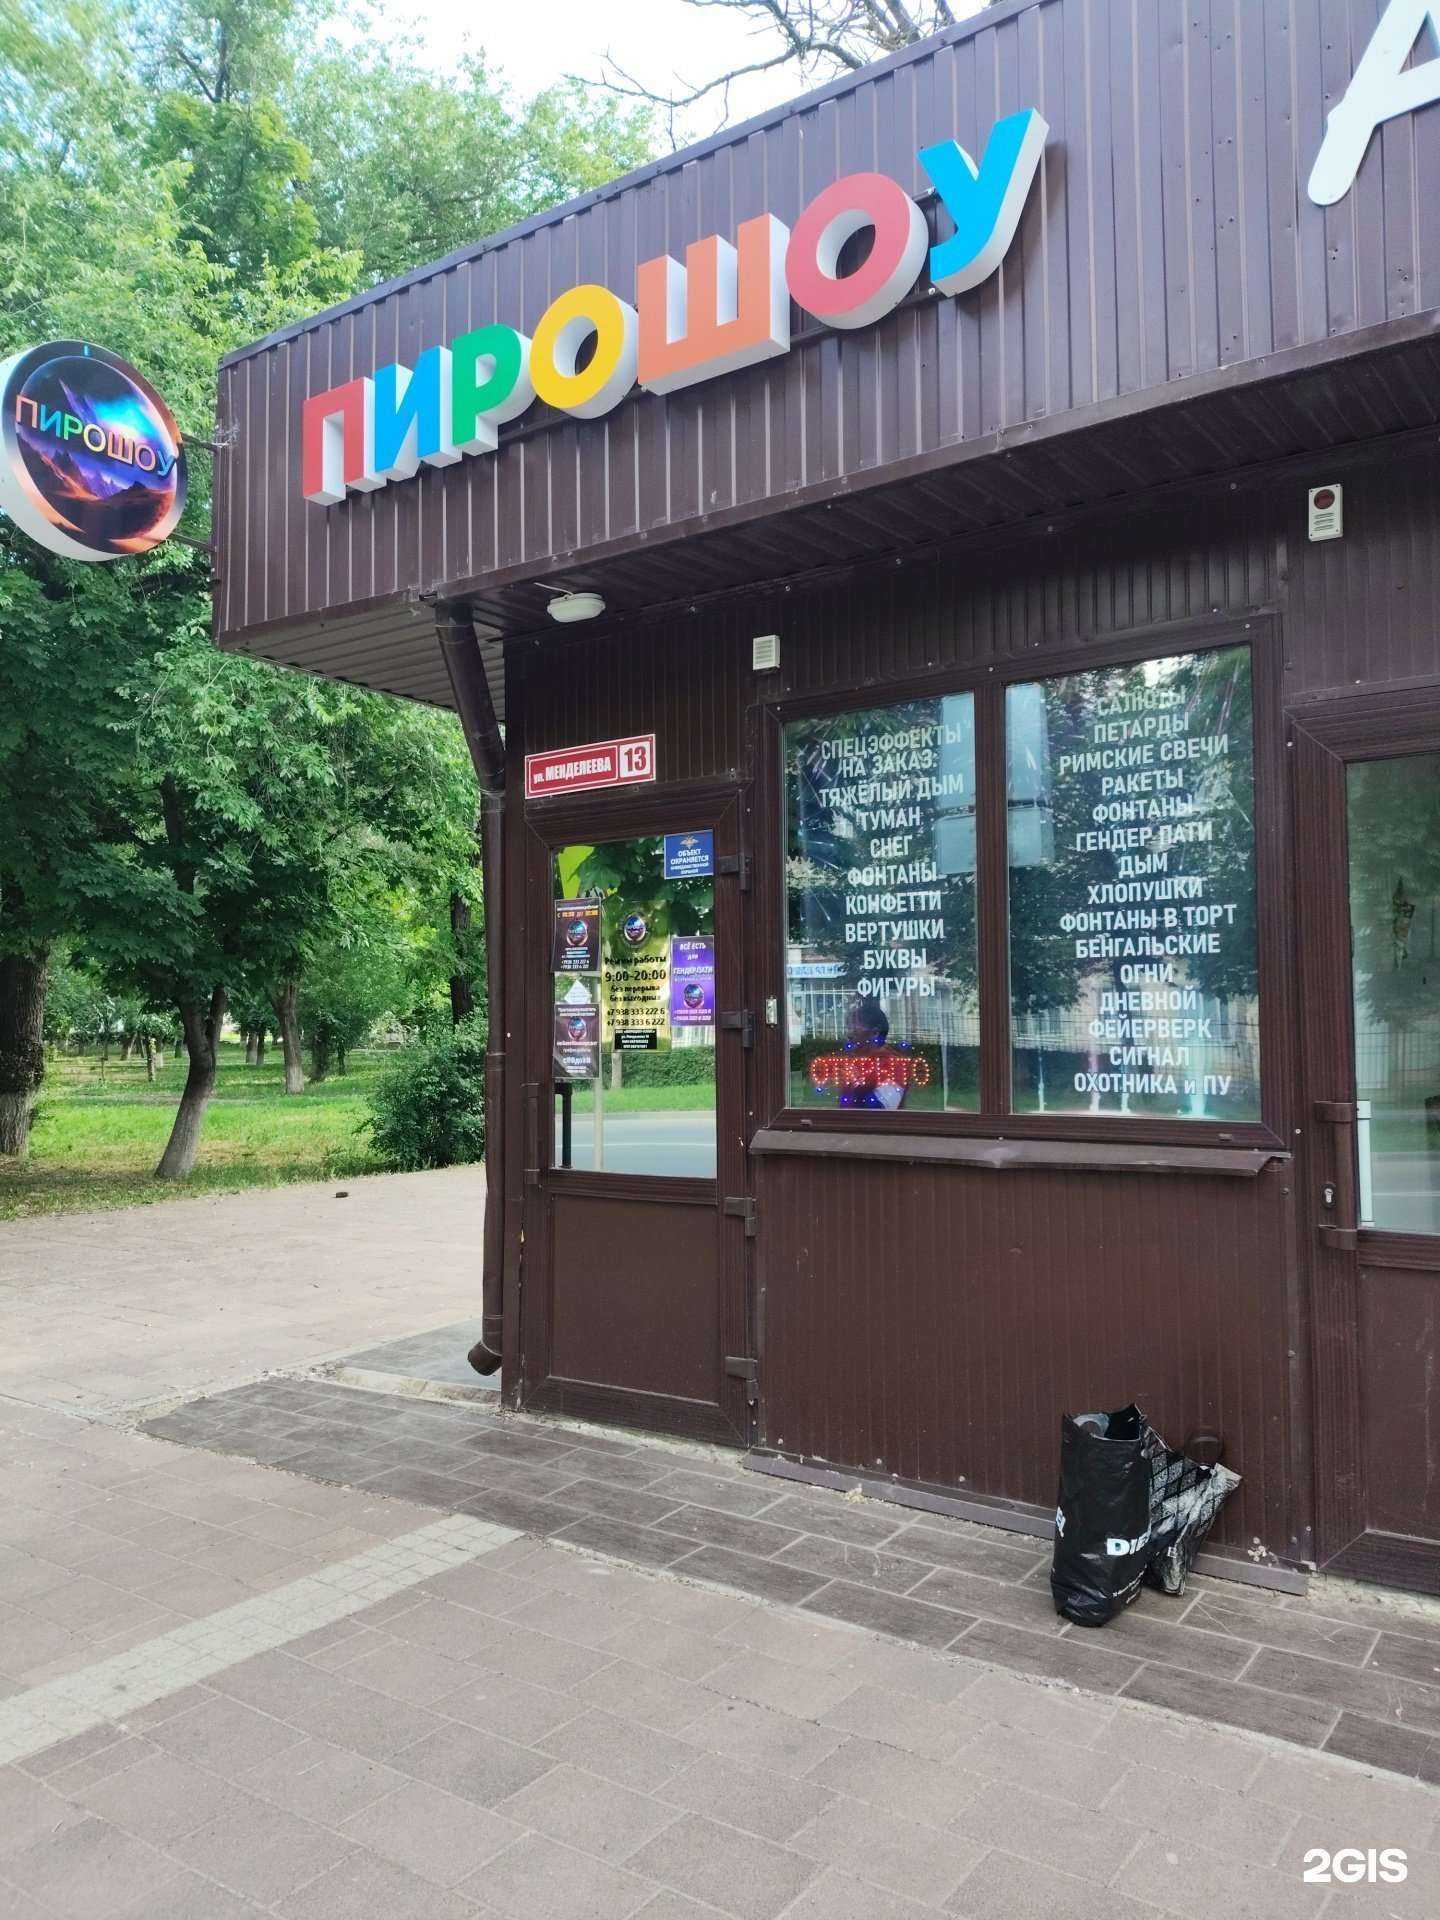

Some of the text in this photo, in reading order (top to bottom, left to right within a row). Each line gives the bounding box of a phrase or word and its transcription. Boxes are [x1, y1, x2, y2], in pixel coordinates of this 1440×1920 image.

[303, 107, 1049, 506] ПИРОШОУ
[16, 394, 177, 477] ПИРОШОУ
[821, 723, 961, 760] СПЕЦЭФФЕКТЫ
[1094, 712, 1189, 743] ПЕТАРДЫ
[533, 746, 647, 784] ул. МЕНДЕЛЕЕВА 13
[842, 749, 938, 778] НА ЗАКАЗ:
[1059, 734, 1229, 775] РИМСКИЕ СВЕЧИ
[819, 773, 964, 808] ТЯЖЁЛЫЙ ДЫМ
[1101, 768, 1184, 796] РАКЕТЫ
[858, 806, 922, 832] ТУМАН
[1092, 793, 1194, 823] ФОНТАНЫ
[870, 835, 913, 858] СНЕГ
[1076, 821, 1213, 852] ГЕНДЕР ПАТИ
[847, 862, 937, 887] ФОНТАНЫ
[1118, 853, 1168, 878] ДЫМ
[846, 890, 942, 915] КОНФЕТТИ
[1088, 876, 1203, 904] ХЛОПУШКИ
[845, 919, 944, 944] ВЕРТУШКИ
[1060, 904, 1237, 932] ФОНТАНЫ В ТОРТ
[863, 948, 927, 970] БУКВЫ
[1076, 934, 1221, 959] БЕНГАЛЬСКИЕ
[605, 969, 666, 982] 9:00-20:00
[857, 976, 936, 998] ФИГУРЫ
[1120, 963, 1173, 984] ОГНИ
[1101, 985, 1197, 1014] ДНЕВНОЙ
[1089, 1014, 1212, 1039] ФЕЙЕРВЕРК
[1109, 1046, 1190, 1067] СИГНАЛ
[811, 1057, 931, 1086] ОТКРЫТО
[1074, 1072, 1232, 1095] ОХОТНИКА и ПУ
